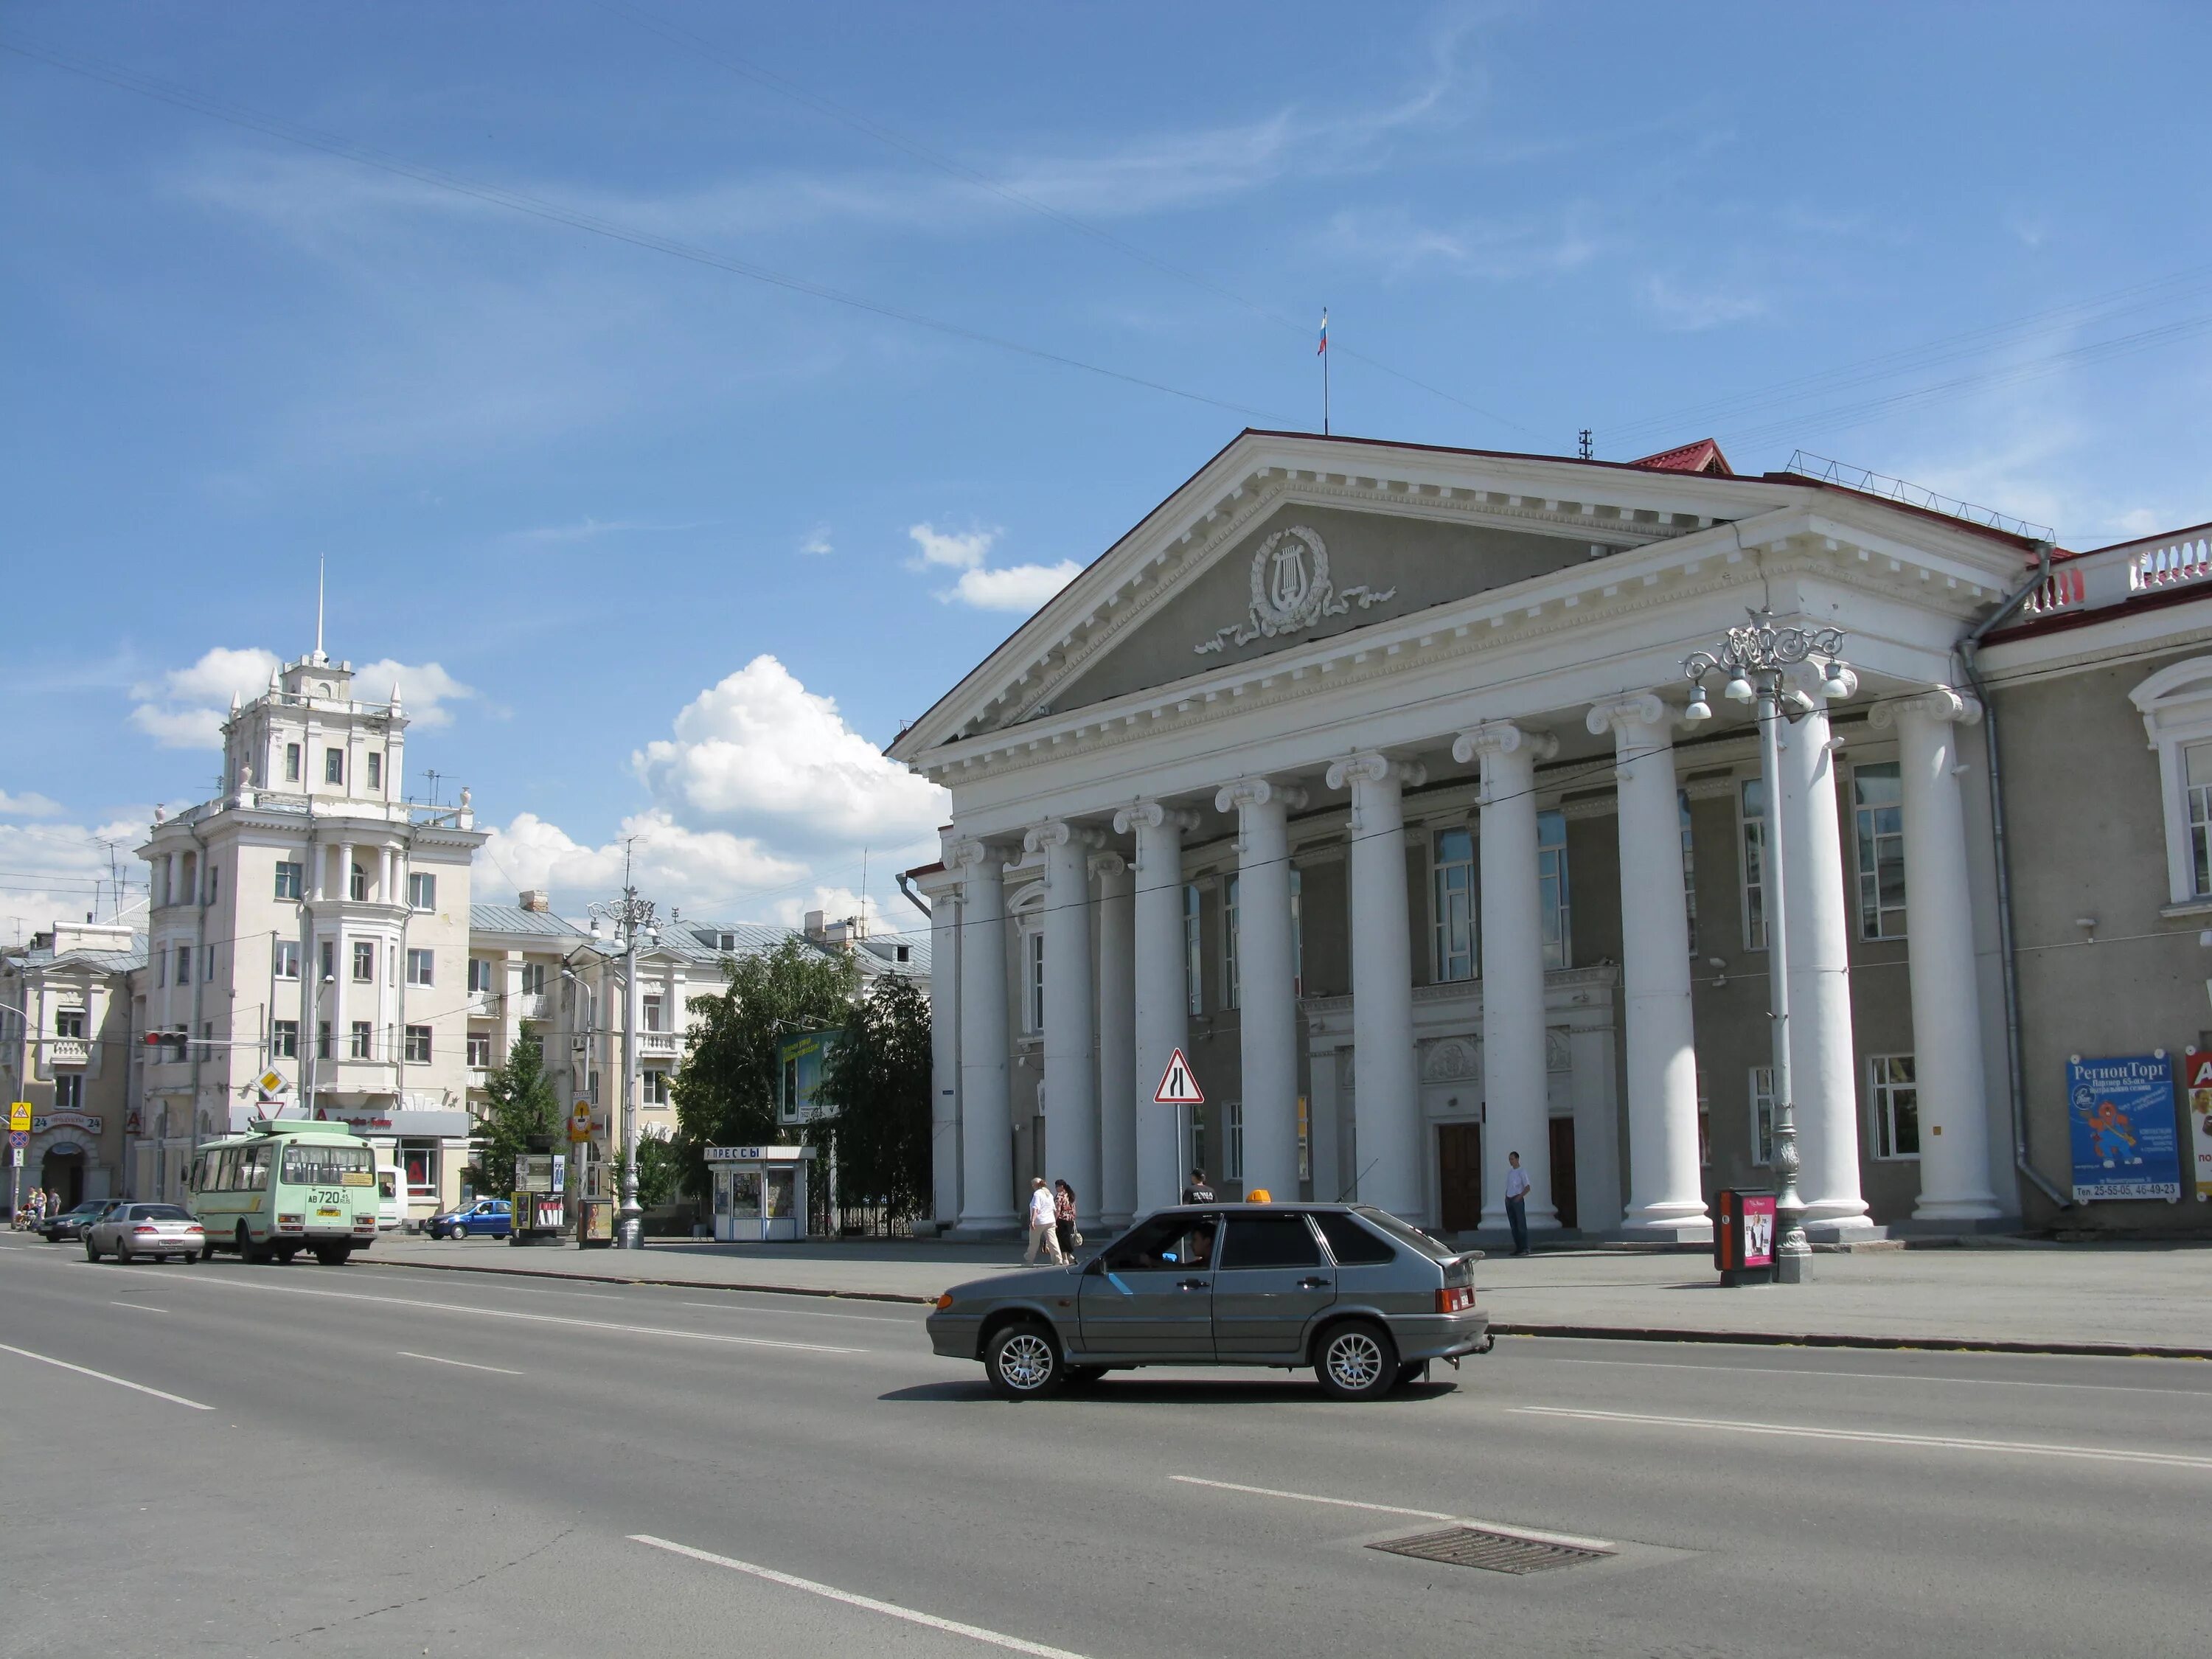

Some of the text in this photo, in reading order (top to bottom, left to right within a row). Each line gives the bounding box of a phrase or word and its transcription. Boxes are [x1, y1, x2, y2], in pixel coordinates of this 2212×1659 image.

[2093, 1079, 2121, 1088] Партнер
[34, 1118, 47, 1127] 24
[87, 1119, 100, 1127] 24
[127, 1112, 140, 1127] А
[713, 1148, 759, 1158] ПРЕССЫ
[2077, 1184, 2175, 1197] Тел. 25-55-05, 46-49-23
[318, 1191, 340, 1204] 720
